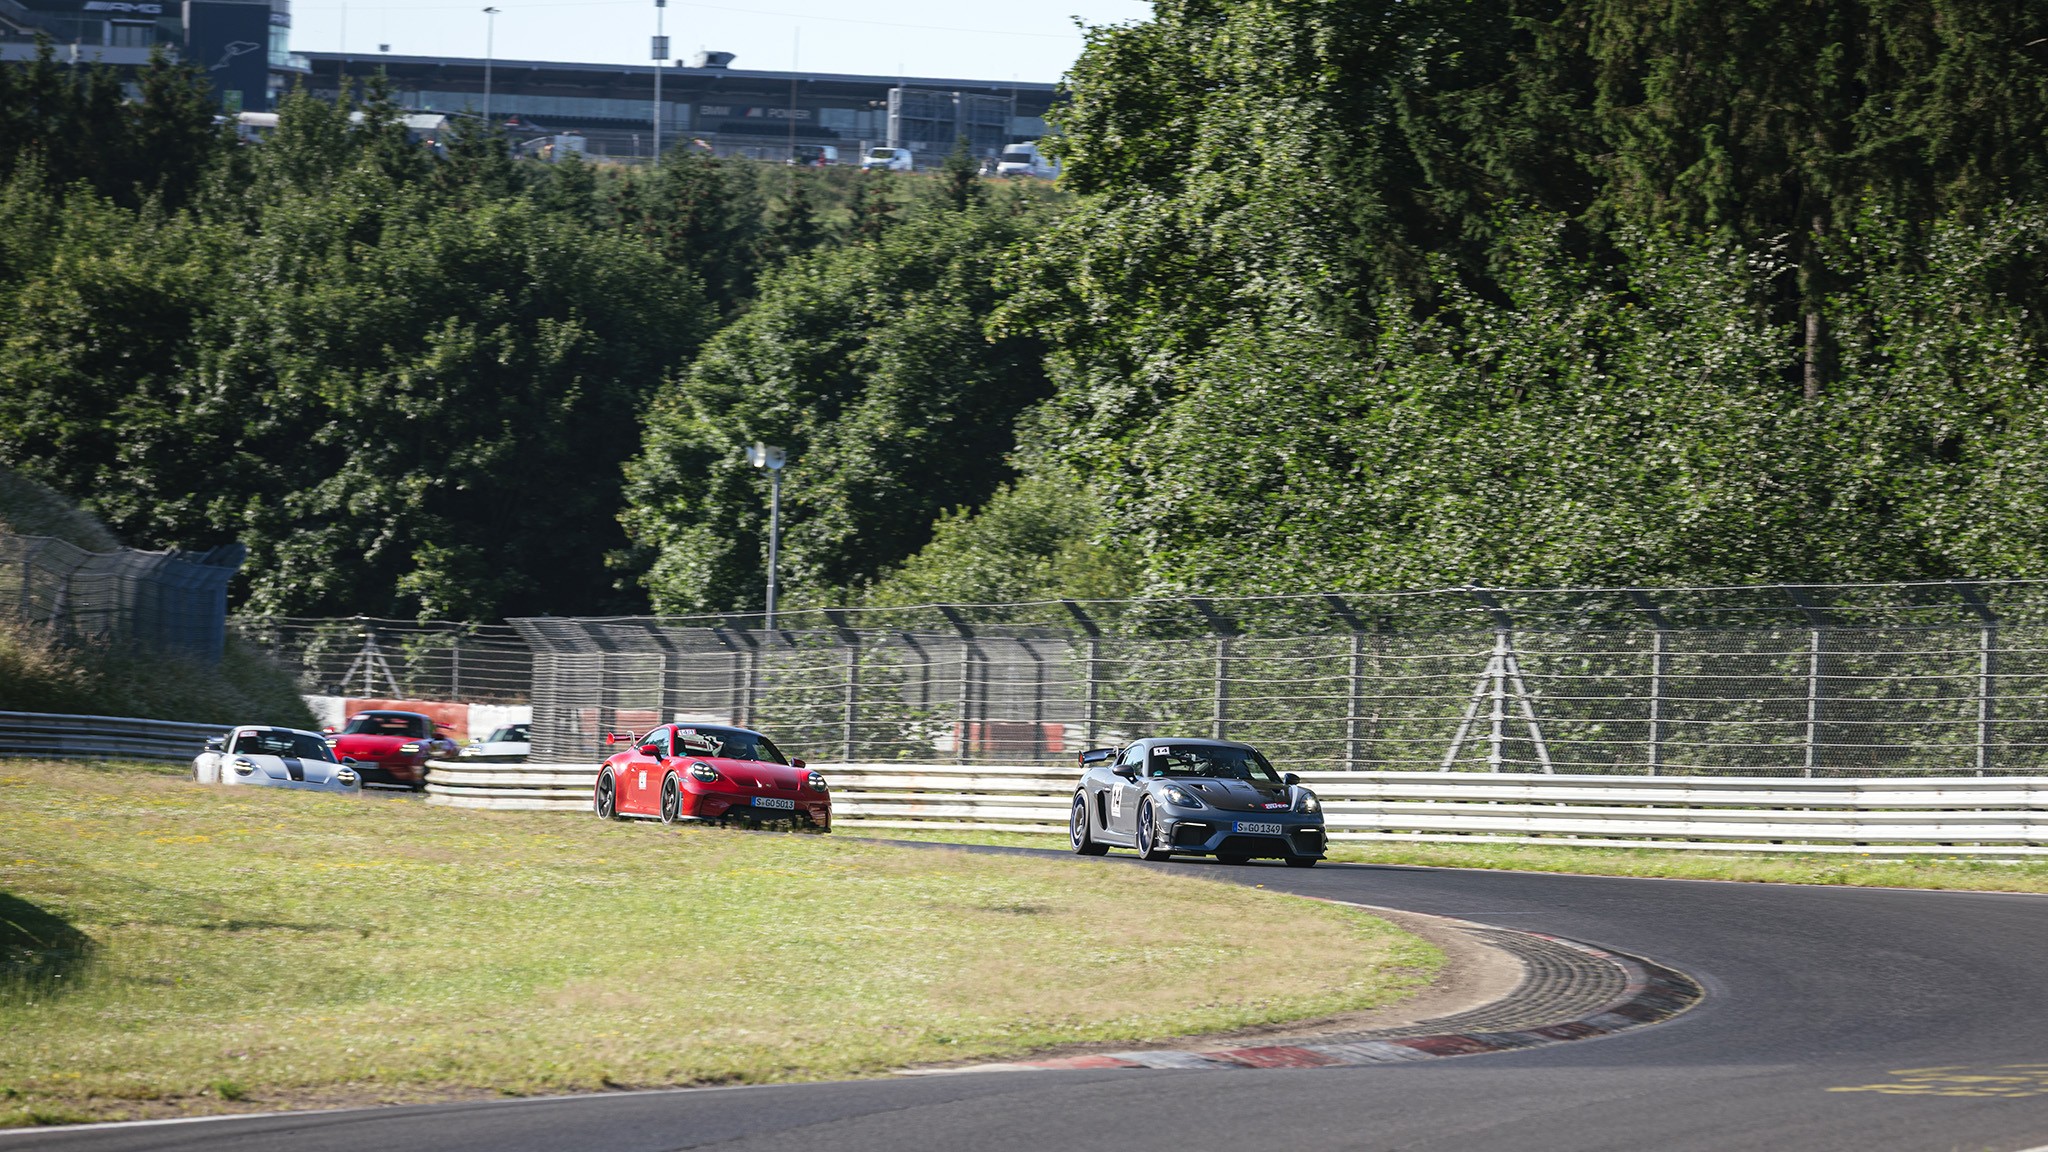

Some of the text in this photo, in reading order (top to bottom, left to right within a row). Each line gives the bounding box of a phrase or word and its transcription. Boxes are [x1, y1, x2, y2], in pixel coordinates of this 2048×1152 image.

[108, 2, 162, 13] AMG
[699, 105, 732, 116] BMW
[767, 108, 811, 120] POWER
[1260, 824, 1281, 834] 1349
